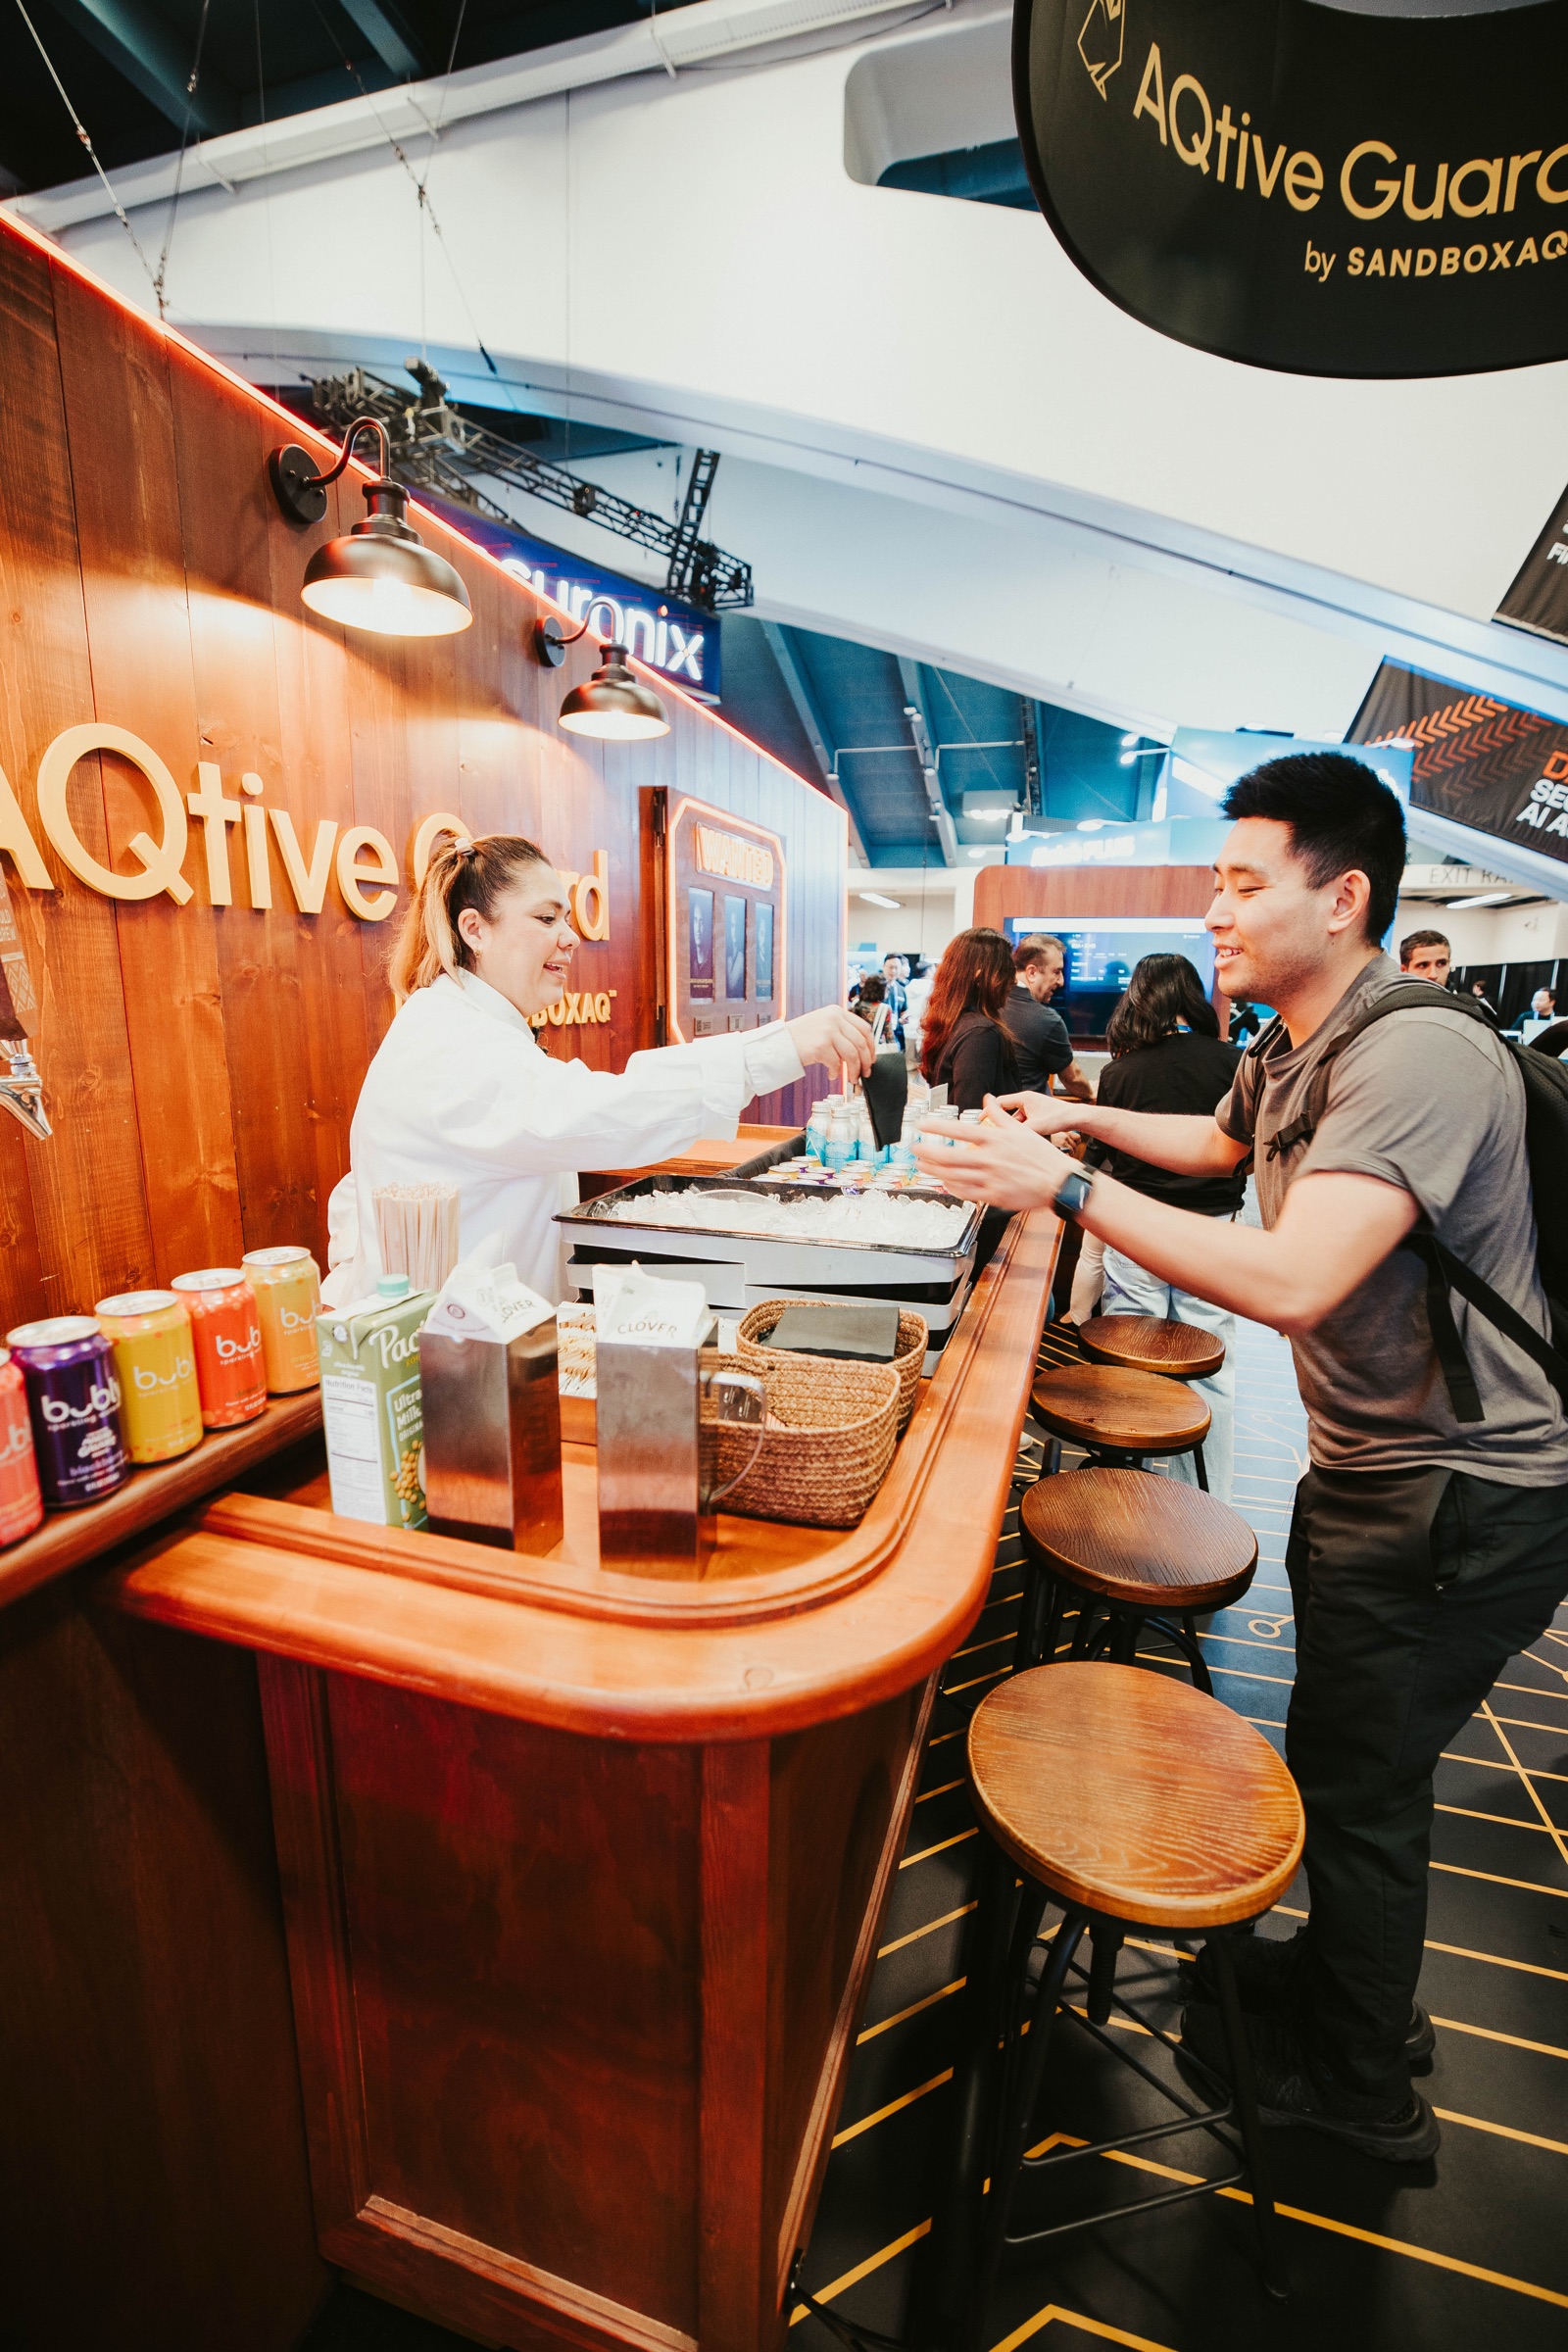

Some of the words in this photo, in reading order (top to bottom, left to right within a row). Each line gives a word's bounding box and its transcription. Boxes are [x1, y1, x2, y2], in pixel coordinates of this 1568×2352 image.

[1132, 41, 1324, 212] AQtive
[1304, 240, 1337, 282] by
[1347, 229, 1568, 278] SANDBOXAQ
[699, 826, 774, 885] WANTED
[1430, 866, 1471, 884] EXIT
[368, 1319, 425, 1370] Pac
[617, 1320, 678, 1339] CLOVER
[324, 1378, 355, 1392] Nutrition
[356, 1383, 374, 1395] Facts
